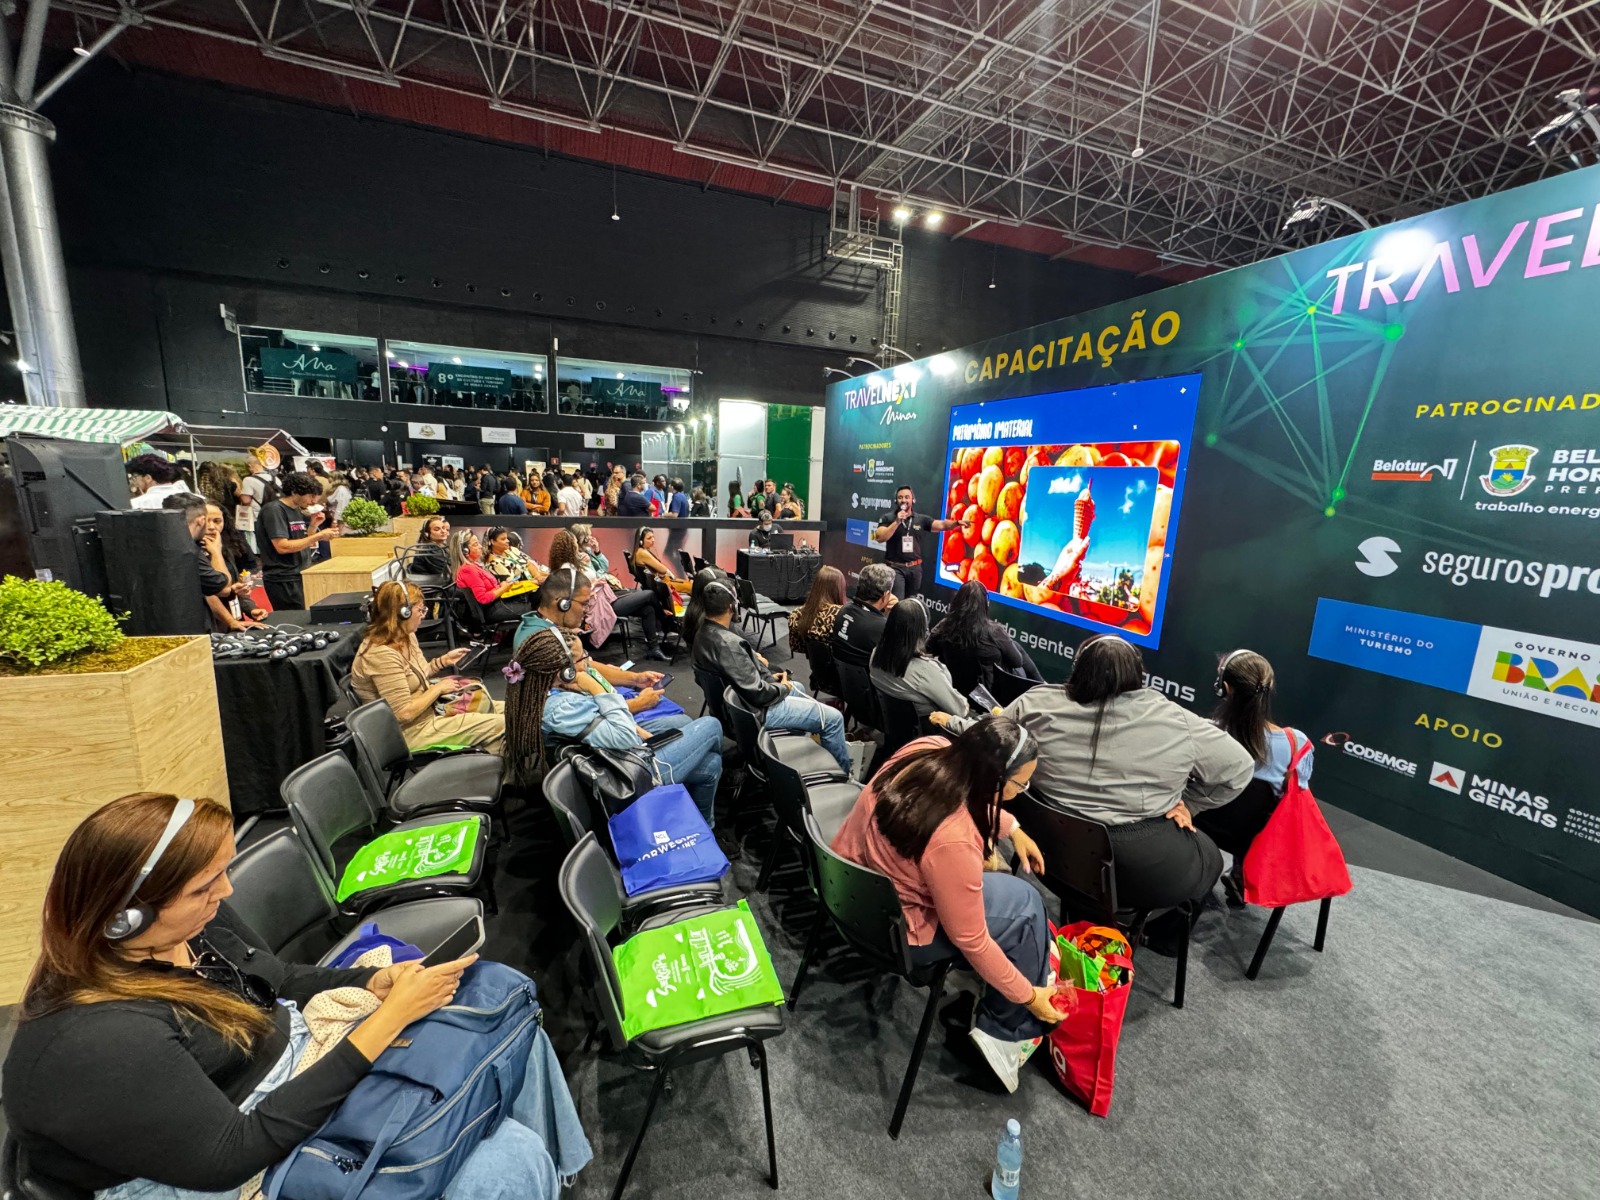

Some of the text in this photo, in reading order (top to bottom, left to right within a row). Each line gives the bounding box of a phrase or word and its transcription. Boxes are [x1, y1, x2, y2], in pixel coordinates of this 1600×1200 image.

[964, 310, 1181, 384] CAPACITAÇÃO
[879, 405, 917, 425] Minas
[993, 419, 1034, 440] IMATERIAL
[1372, 459, 1428, 473] Belotur
[1475, 501, 1545, 514] trabalho
[1019, 631, 1075, 659] agente
[1345, 625, 1434, 650] MINISTÉRIO DO
[1360, 638, 1412, 656] TURISMO
[1514, 641, 1591, 662] GOVERNO
[1502, 688, 1538, 702] UNIÃO
[1415, 713, 1503, 748] APOIO
[1343, 741, 1418, 775] CODEMGE
[1470, 774, 1550, 811] MINAS
[1468, 789, 1558, 828] GERAIS
